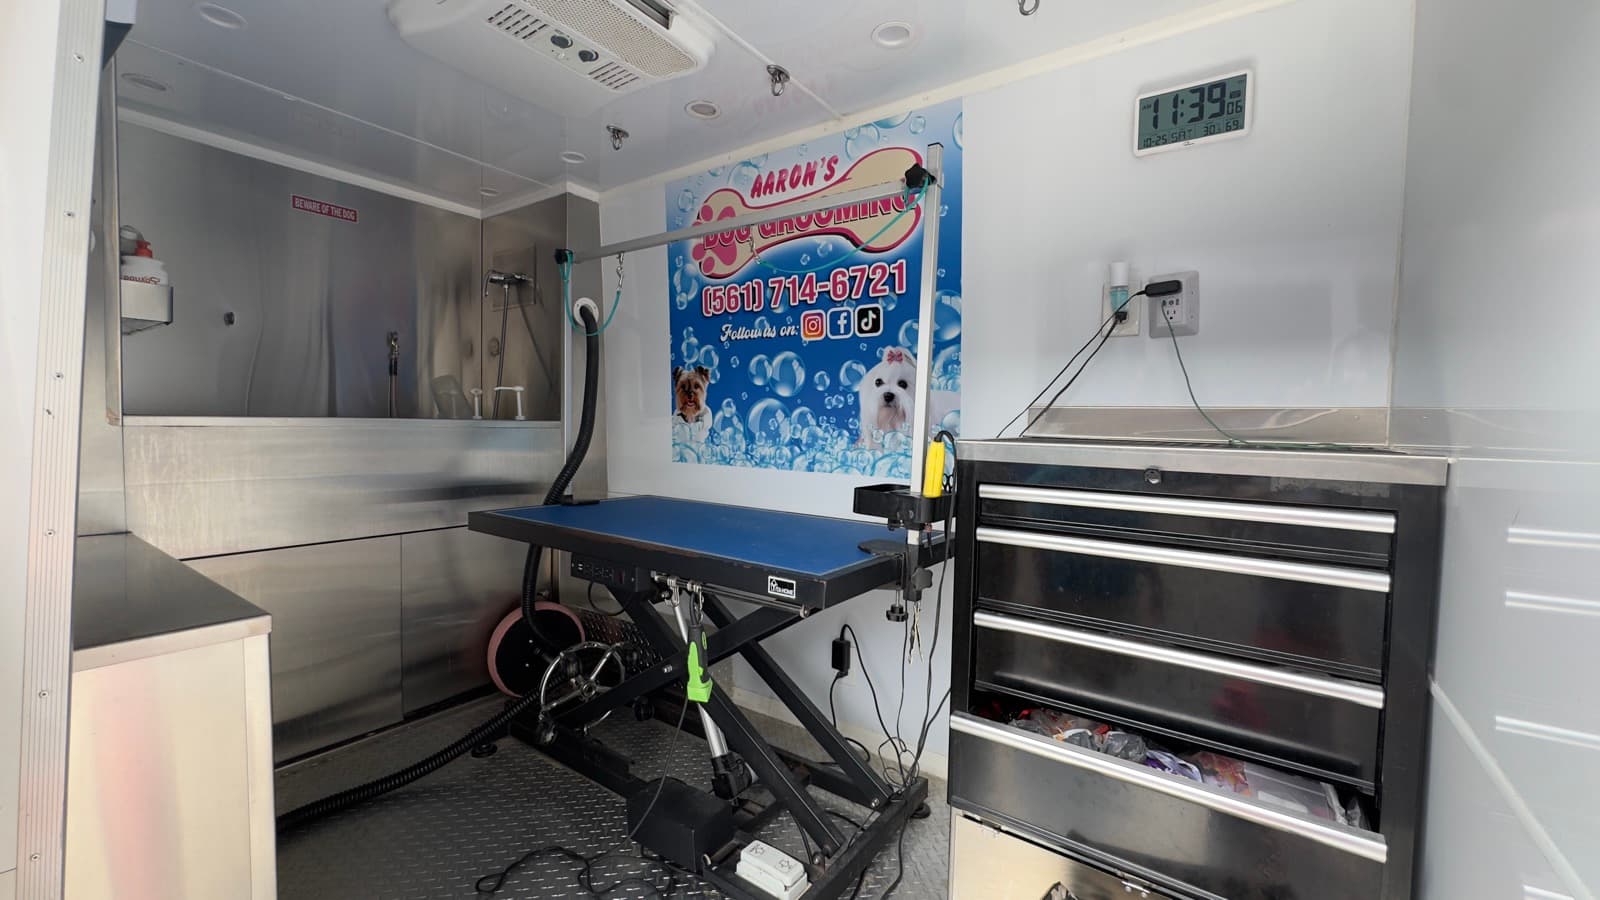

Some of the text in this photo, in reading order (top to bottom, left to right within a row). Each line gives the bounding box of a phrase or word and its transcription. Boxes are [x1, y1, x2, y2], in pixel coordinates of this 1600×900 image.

[1153, 82, 1226, 130] 11:39
[1226, 100, 1242, 115] 06
[1143, 134, 1167, 149] 10-25
[1171, 128, 1192, 142] SAT
[750, 155, 839, 199] AARON'S
[295, 198, 355, 220] BEWARE OF THE DOG
[702, 259, 907, 317] (561) 714-6721
[720, 323, 799, 342] Follow us on:
